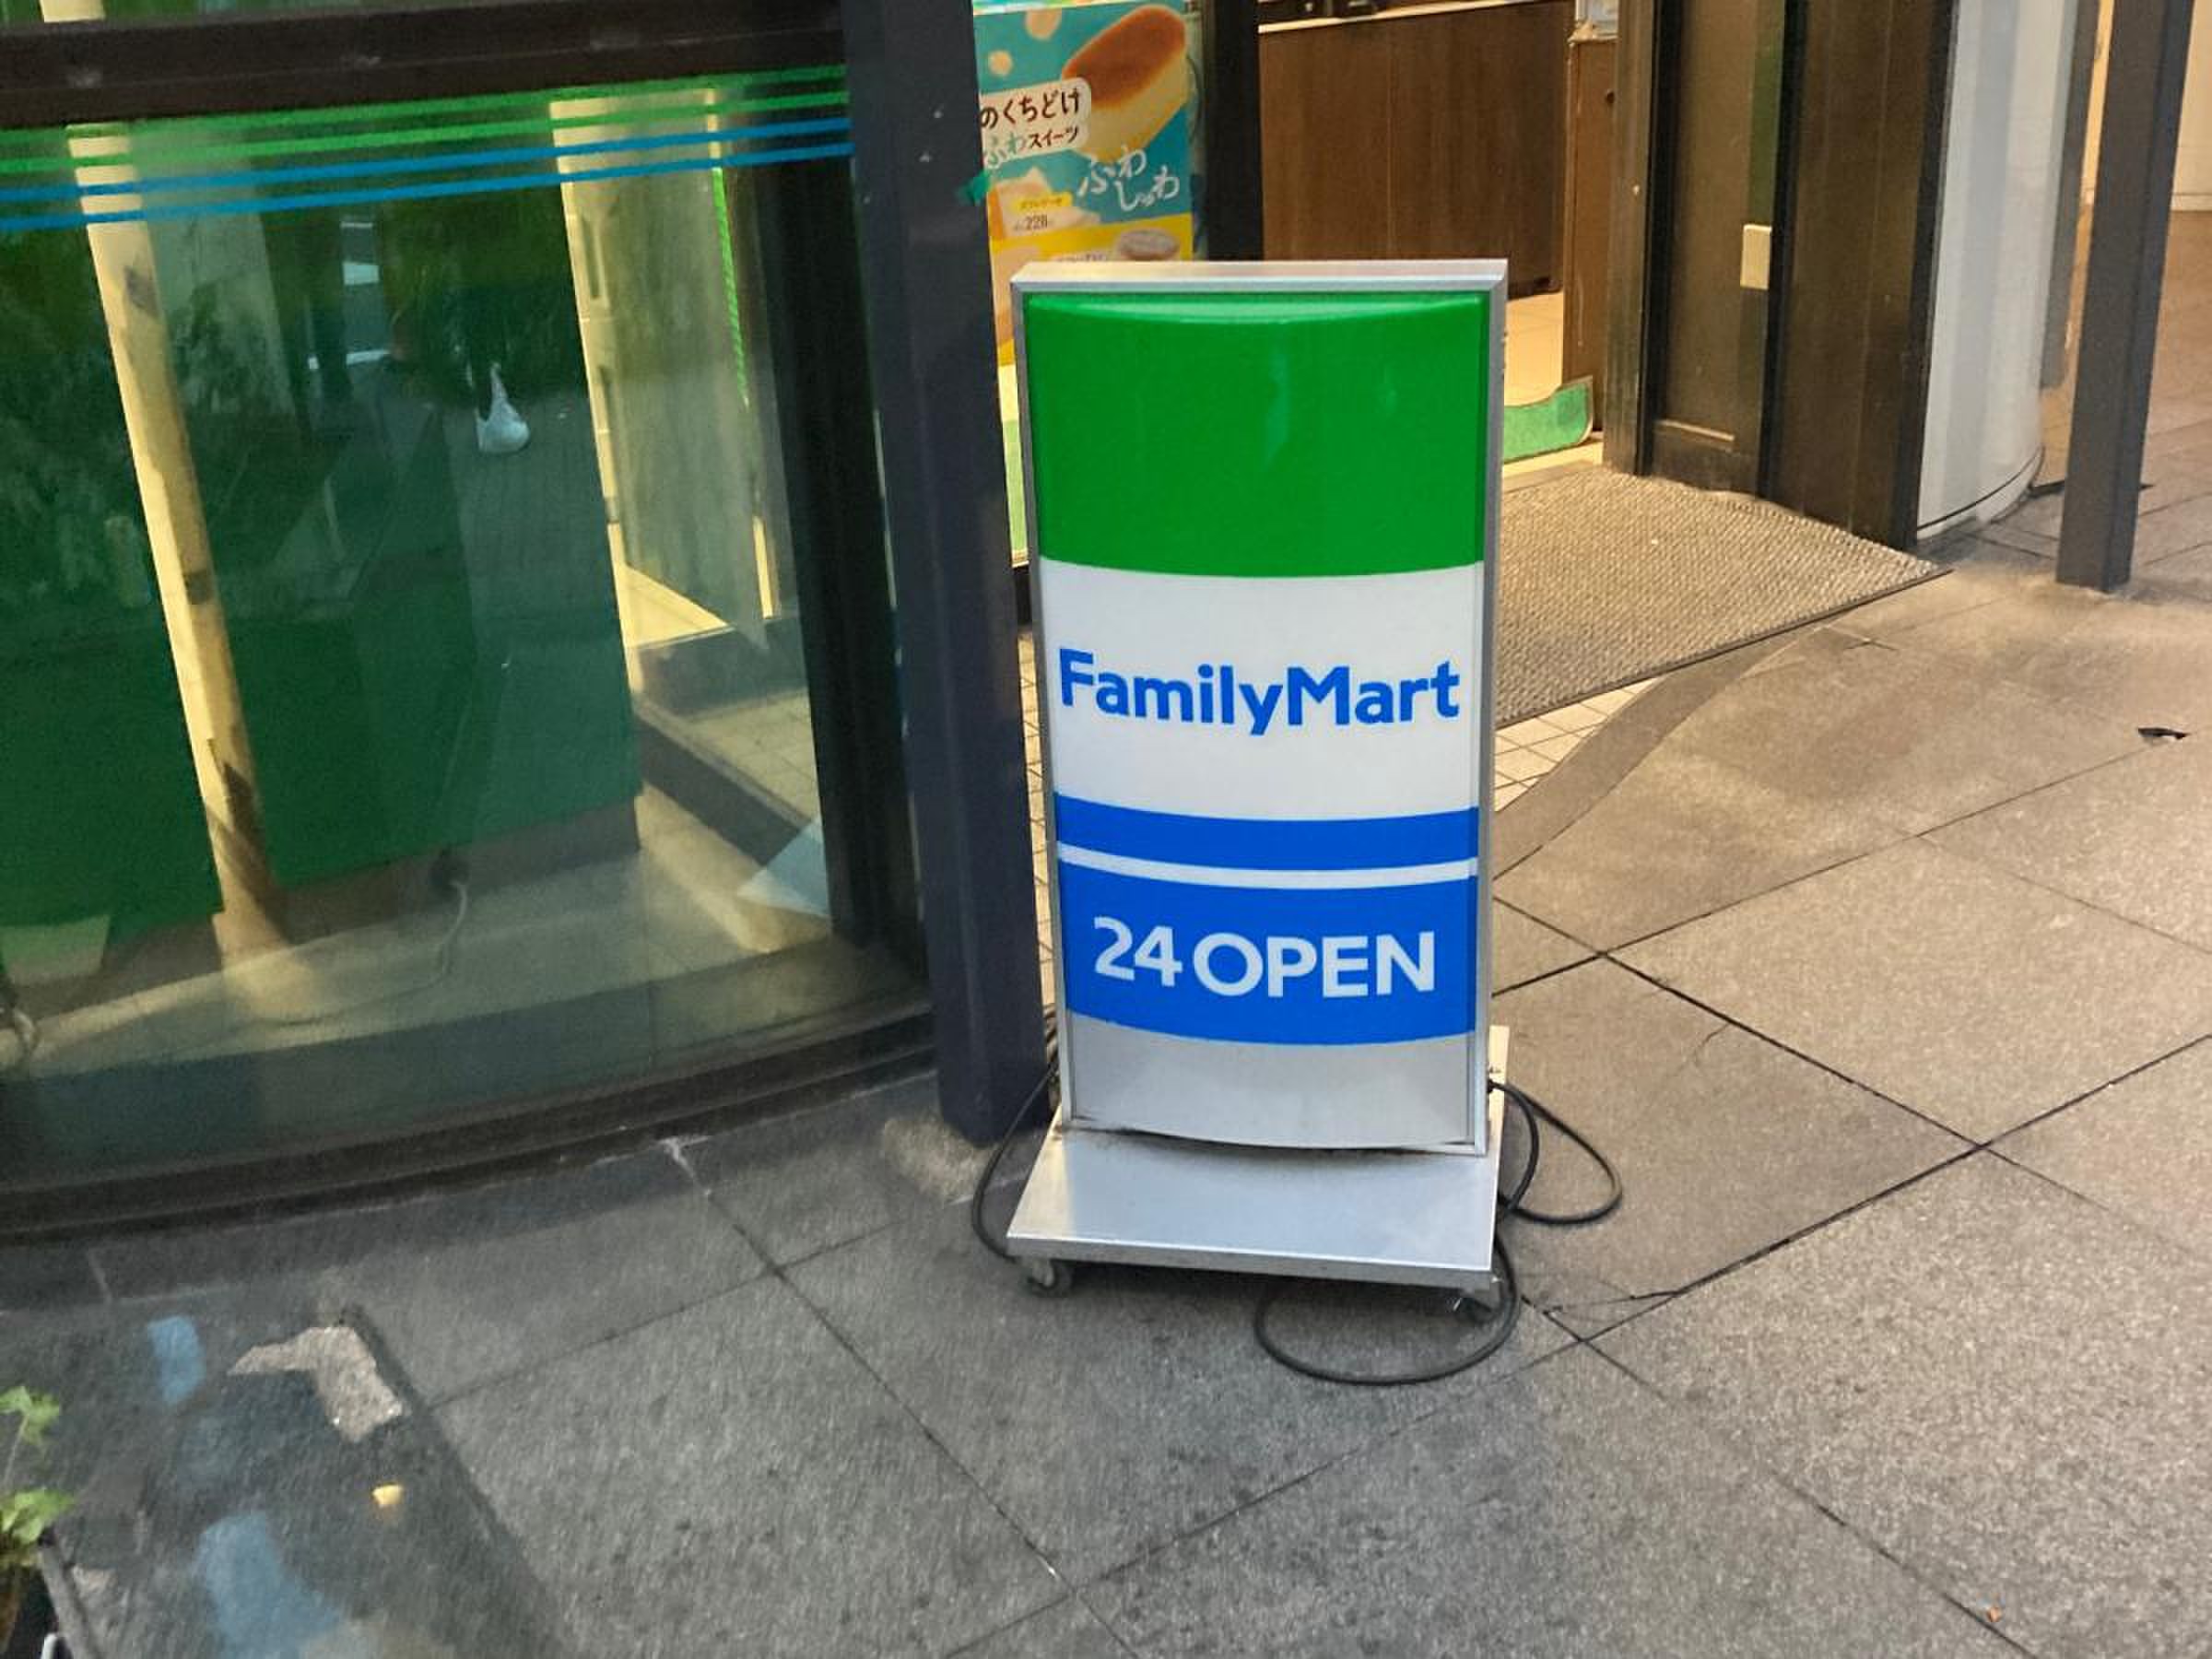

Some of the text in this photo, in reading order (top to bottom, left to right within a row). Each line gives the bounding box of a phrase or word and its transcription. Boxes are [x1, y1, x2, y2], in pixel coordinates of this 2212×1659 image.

[980, 87, 1079, 129] のくちどけ
[1058, 647, 1461, 736] FamilyMart
[1193, 931, 1436, 998] OPEN
